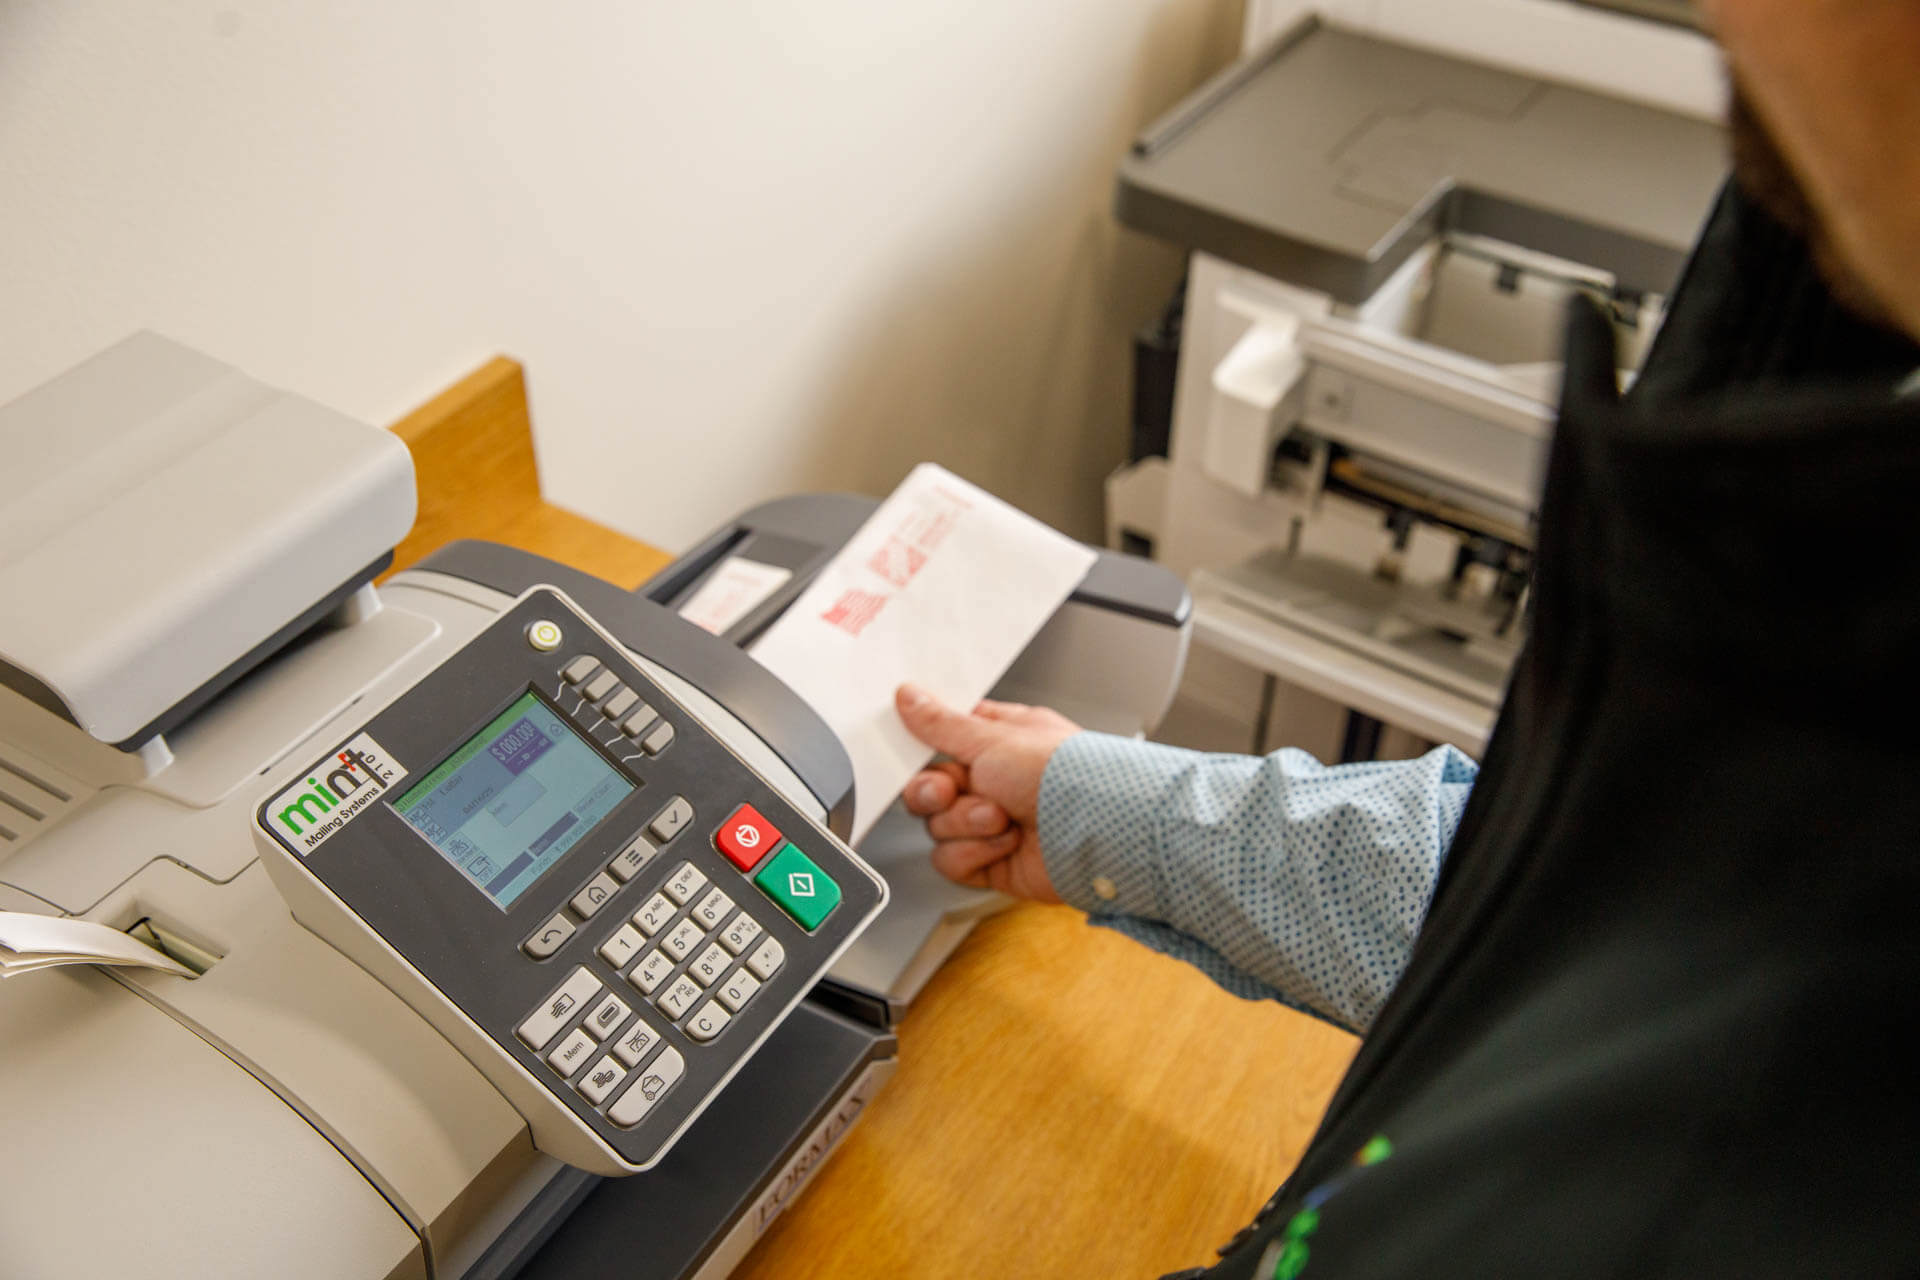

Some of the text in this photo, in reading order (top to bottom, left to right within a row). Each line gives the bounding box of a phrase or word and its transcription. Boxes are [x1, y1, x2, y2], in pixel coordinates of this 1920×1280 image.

[304, 816, 345, 847] Mailing
[339, 786, 380, 819] Systems
[674, 883, 688, 895] 3
[645, 899, 665, 926] 2 ABC
[703, 908, 715, 920] 6
[619, 938, 631, 950] 1
[672, 937, 686, 950] 5
[730, 932, 743, 945] 9
[701, 963, 714, 975] 8
[643, 970, 656, 983] 4
[728, 987, 741, 1000] 0
[669, 994, 682, 1008] 7
[698, 1018, 713, 1031] C
[563, 1041, 585, 1061] Mem
